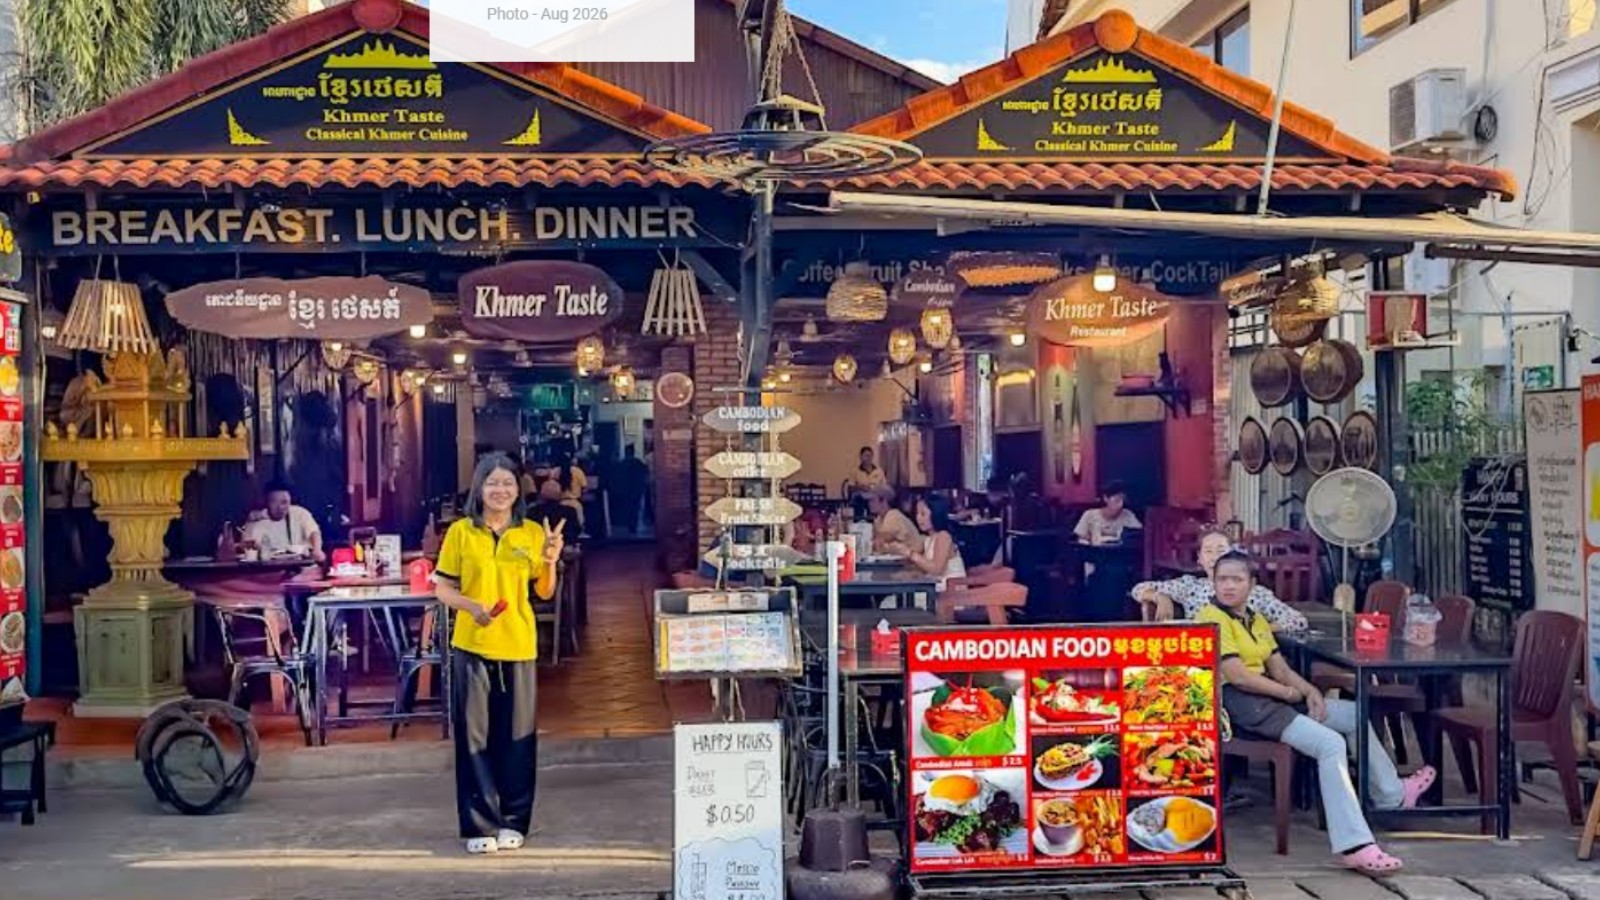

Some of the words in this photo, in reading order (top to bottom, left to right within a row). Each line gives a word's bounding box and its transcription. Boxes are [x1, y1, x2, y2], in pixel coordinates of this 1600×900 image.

[323, 109, 389, 123] Khmer
[394, 109, 445, 123] Taste
[305, 128, 365, 141] Classical
[368, 129, 416, 141] Khmer
[418, 128, 469, 141] Cuisine
[1052, 121, 1111, 136] Khmer
[1115, 121, 1160, 136] Taste
[1034, 140, 1087, 151] Classical
[1089, 140, 1131, 151] Khmer
[1133, 140, 1178, 152] Cuisine
[52, 208, 341, 246] BREAKFAST.
[355, 206, 521, 242] LUNCH.
[535, 206, 697, 240] DINNER
[474, 285, 547, 317] Khmer
[554, 284, 609, 316] Taste
[1044, 297, 1105, 321] Khmer
[1110, 295, 1158, 317] Taste
[1069, 325, 1128, 337] Restaurant
[719, 405, 786, 419] CAMBODIAN
[737, 419, 769, 431] food
[915, 639, 1046, 661] CAMBODIAN
[1052, 637, 1111, 658] FOOD
[692, 733, 733, 752] HAPPY
[736, 732, 773, 750] HOURS
